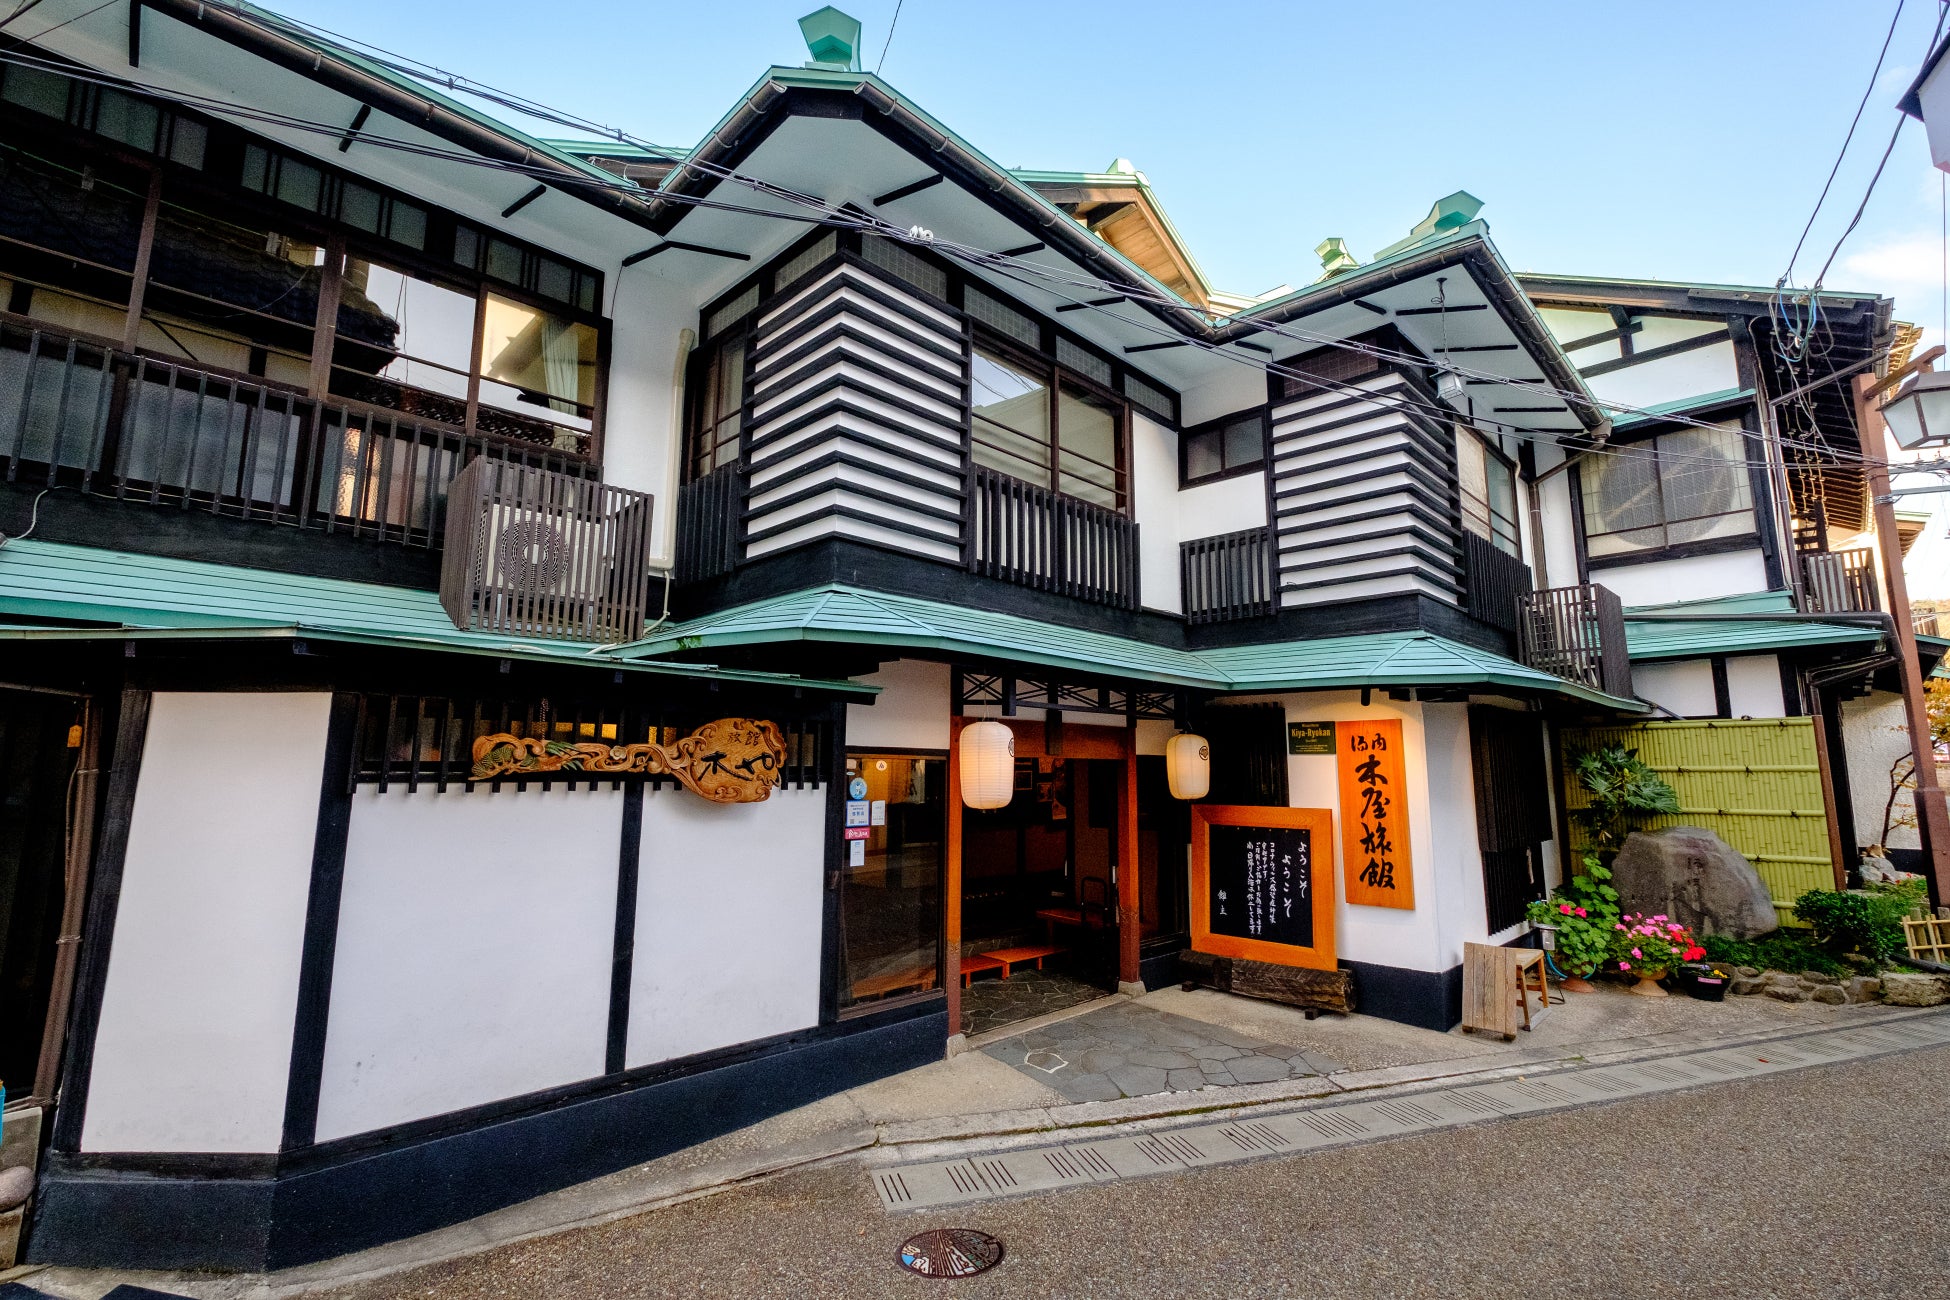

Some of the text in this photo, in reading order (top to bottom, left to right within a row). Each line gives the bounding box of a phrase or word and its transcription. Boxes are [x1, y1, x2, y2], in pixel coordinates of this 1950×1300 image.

[727, 730, 760, 747] 旅館
[1291, 728, 1331, 739] Kiya-Ryokan
[1355, 754, 1396, 890] 木屋旅館
[1282, 854, 1292, 918] ようこそ
[1298, 841, 1308, 899] ようこそ
